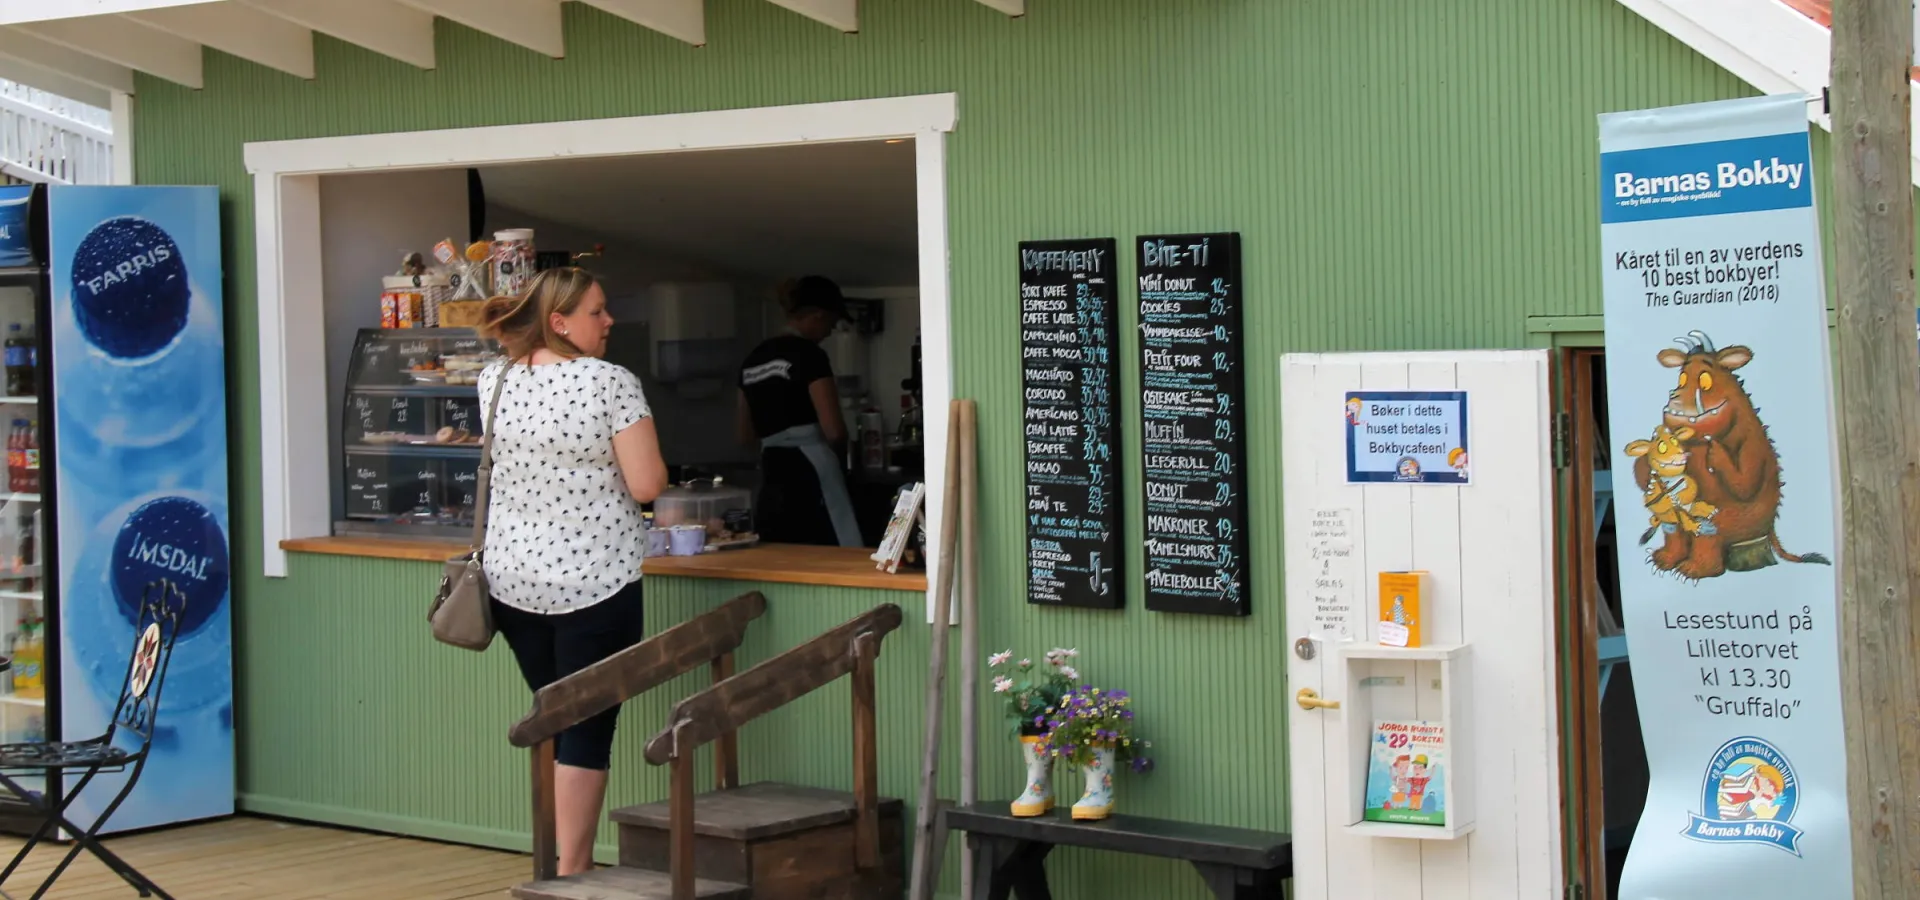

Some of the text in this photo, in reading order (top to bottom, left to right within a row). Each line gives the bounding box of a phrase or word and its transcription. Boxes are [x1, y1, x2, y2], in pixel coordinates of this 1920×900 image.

[1614, 157, 1804, 198] Barnas Bokby
[1630, 198, 1639, 207] by
[1639, 197, 1652, 205] full
[1660, 194, 1689, 204] magiske
[1616, 241, 1803, 271] Kåret til en av verdens
[86, 244, 171, 296] FARRIS
[1642, 261, 1780, 288] 10 best bokbyer!
[1043, 284, 1067, 298] KAFFE
[1164, 278, 1196, 291] DONUT
[1646, 284, 1779, 307] The Guardian (2018)
[1024, 300, 1067, 311] ESPRESSO
[1140, 300, 1181, 314] COOKIES
[1023, 312, 1049, 325] CAFFE
[1053, 313, 1076, 325] LATTE
[1024, 347, 1050, 358] CAFFE
[1052, 347, 1082, 359] MOCCA
[1174, 355, 1202, 367] FOUR
[1025, 367, 1074, 382] MACCHIATO
[1025, 387, 1066, 400] CORTADO
[1143, 390, 1190, 405] OSTEKAKE
[1025, 406, 1079, 420] AMERICANO
[1371, 405, 1442, 416] Bøker i dette
[1050, 425, 1078, 436] LATTE
[1144, 419, 1185, 439] MUFFIN
[1366, 423, 1448, 435] huset betales i
[1027, 440, 1067, 454] ISKAFFE
[1369, 441, 1446, 456] Bokbycafeen!
[1027, 461, 1060, 474] KAKAO
[1145, 454, 1210, 469] LEFSERULL
[1027, 485, 1041, 496] TE
[1146, 481, 1188, 499] DONUT
[1052, 501, 1068, 512] TE
[1148, 515, 1210, 535] MAKRONER
[128, 532, 209, 581] IMSDAL
[1032, 551, 1072, 562] ESPRESSO
[1032, 560, 1055, 569] KREM
[1664, 605, 1813, 634] Lesestund på
[1687, 638, 1799, 660] Lilletorvet
[1700, 667, 1791, 689] kl 13.30
[1378, 722, 1408, 732] JORDA
[1389, 733, 1408, 749] 29
[1716, 760, 1726, 770] by
[1722, 746, 1736, 762] full
[1735, 744, 1743, 755] av
[1744, 744, 1773, 760] magiske
[1696, 822, 1785, 842] Barnas Bokby
